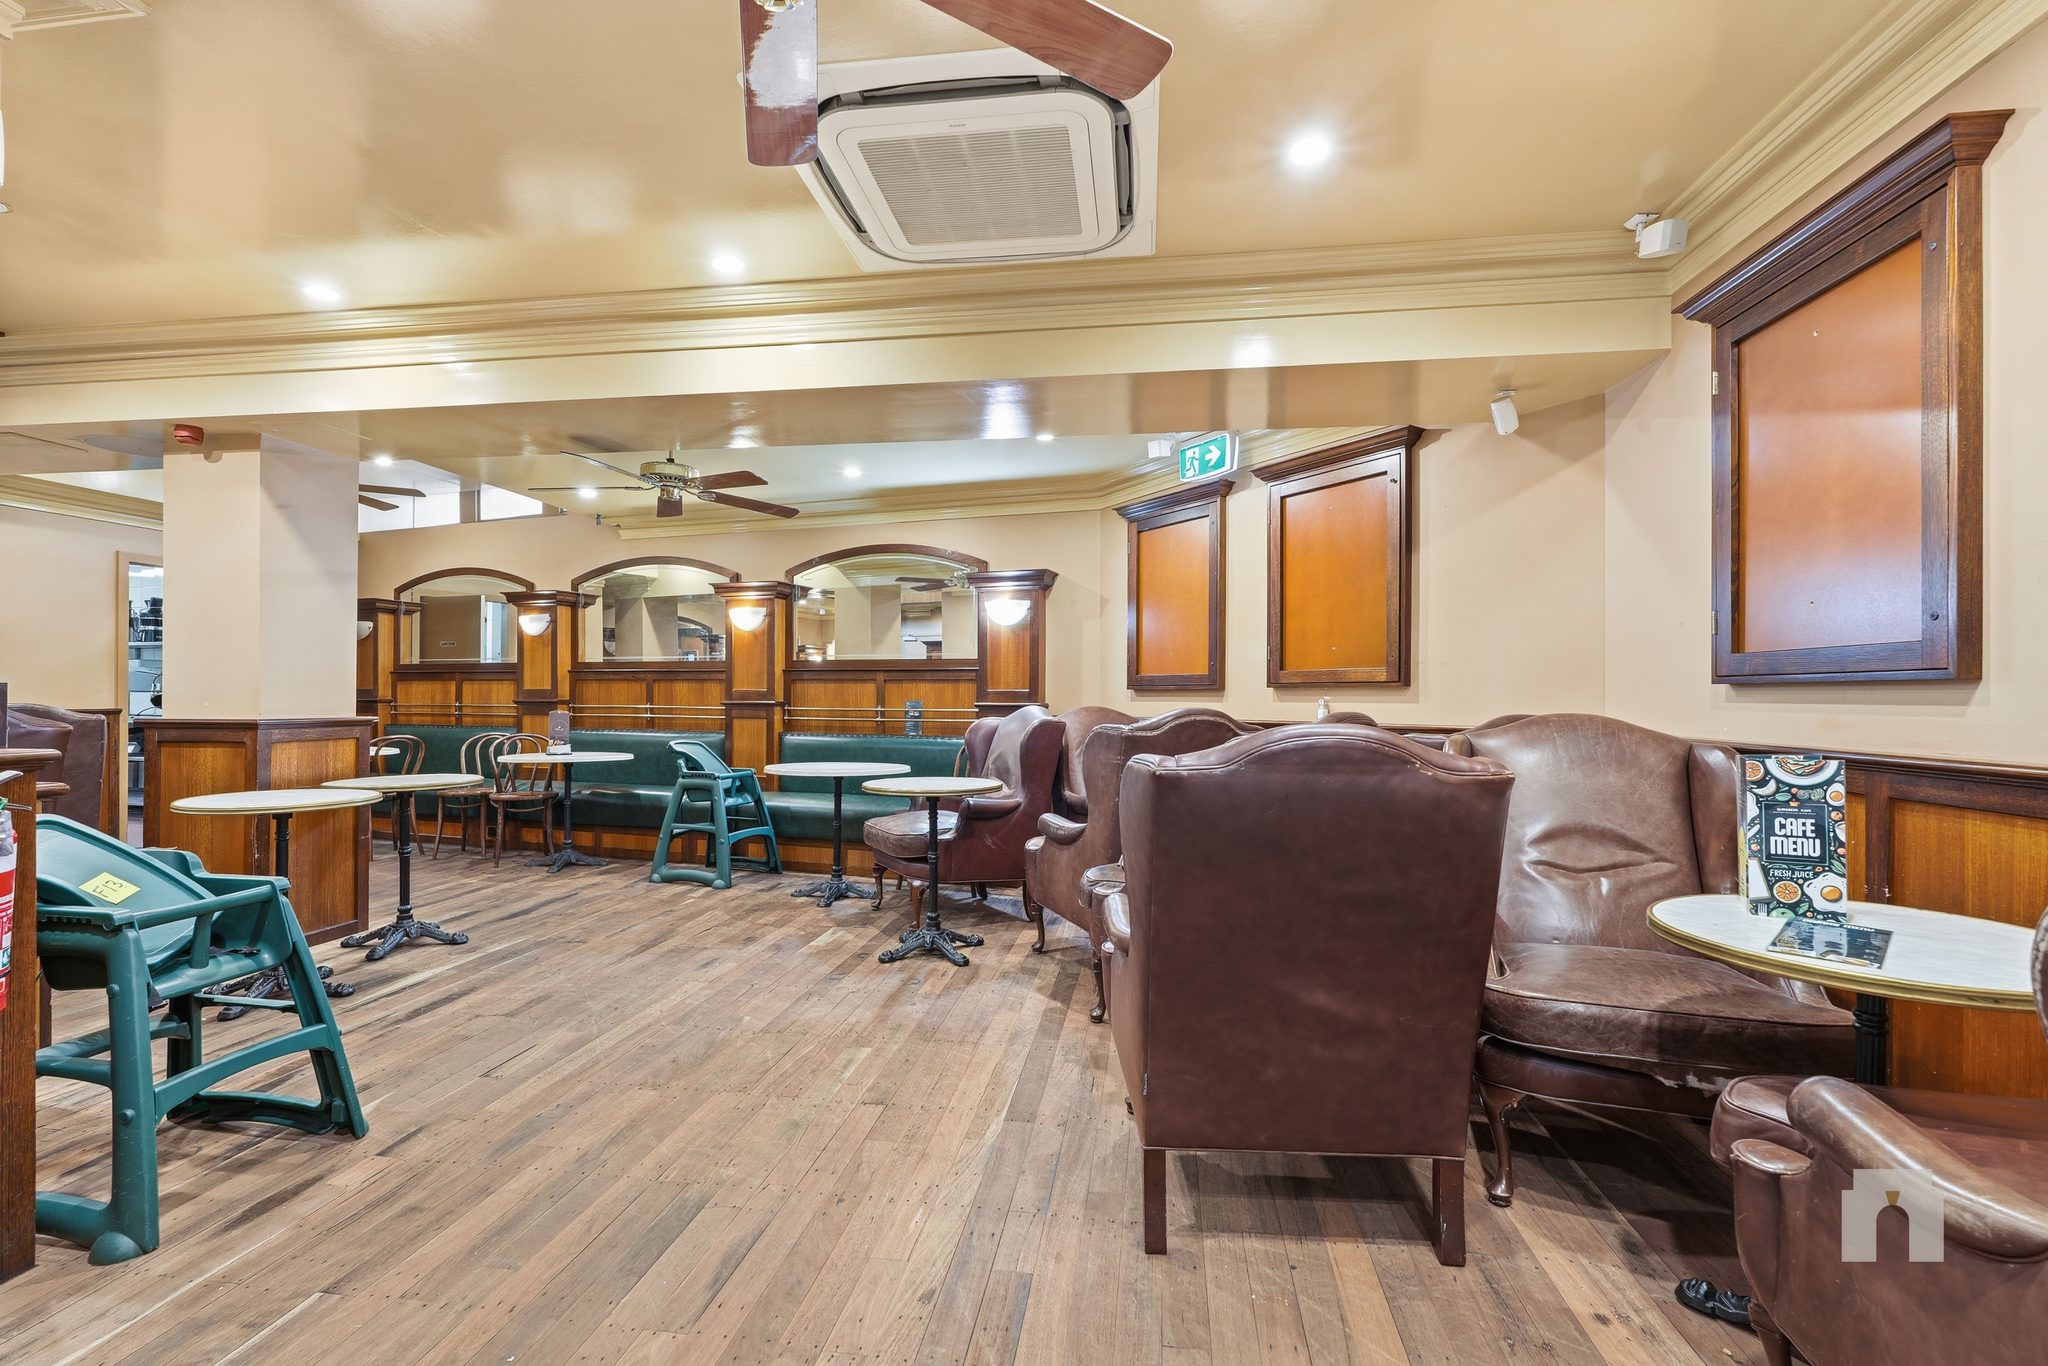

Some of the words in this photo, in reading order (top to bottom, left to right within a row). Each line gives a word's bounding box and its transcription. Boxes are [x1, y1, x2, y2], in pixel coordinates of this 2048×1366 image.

[1774, 817, 1816, 837] CAFE
[1769, 836, 1821, 857] MENU
[1769, 869, 1792, 878] FRESH
[1792, 870, 1814, 879] JUICE
